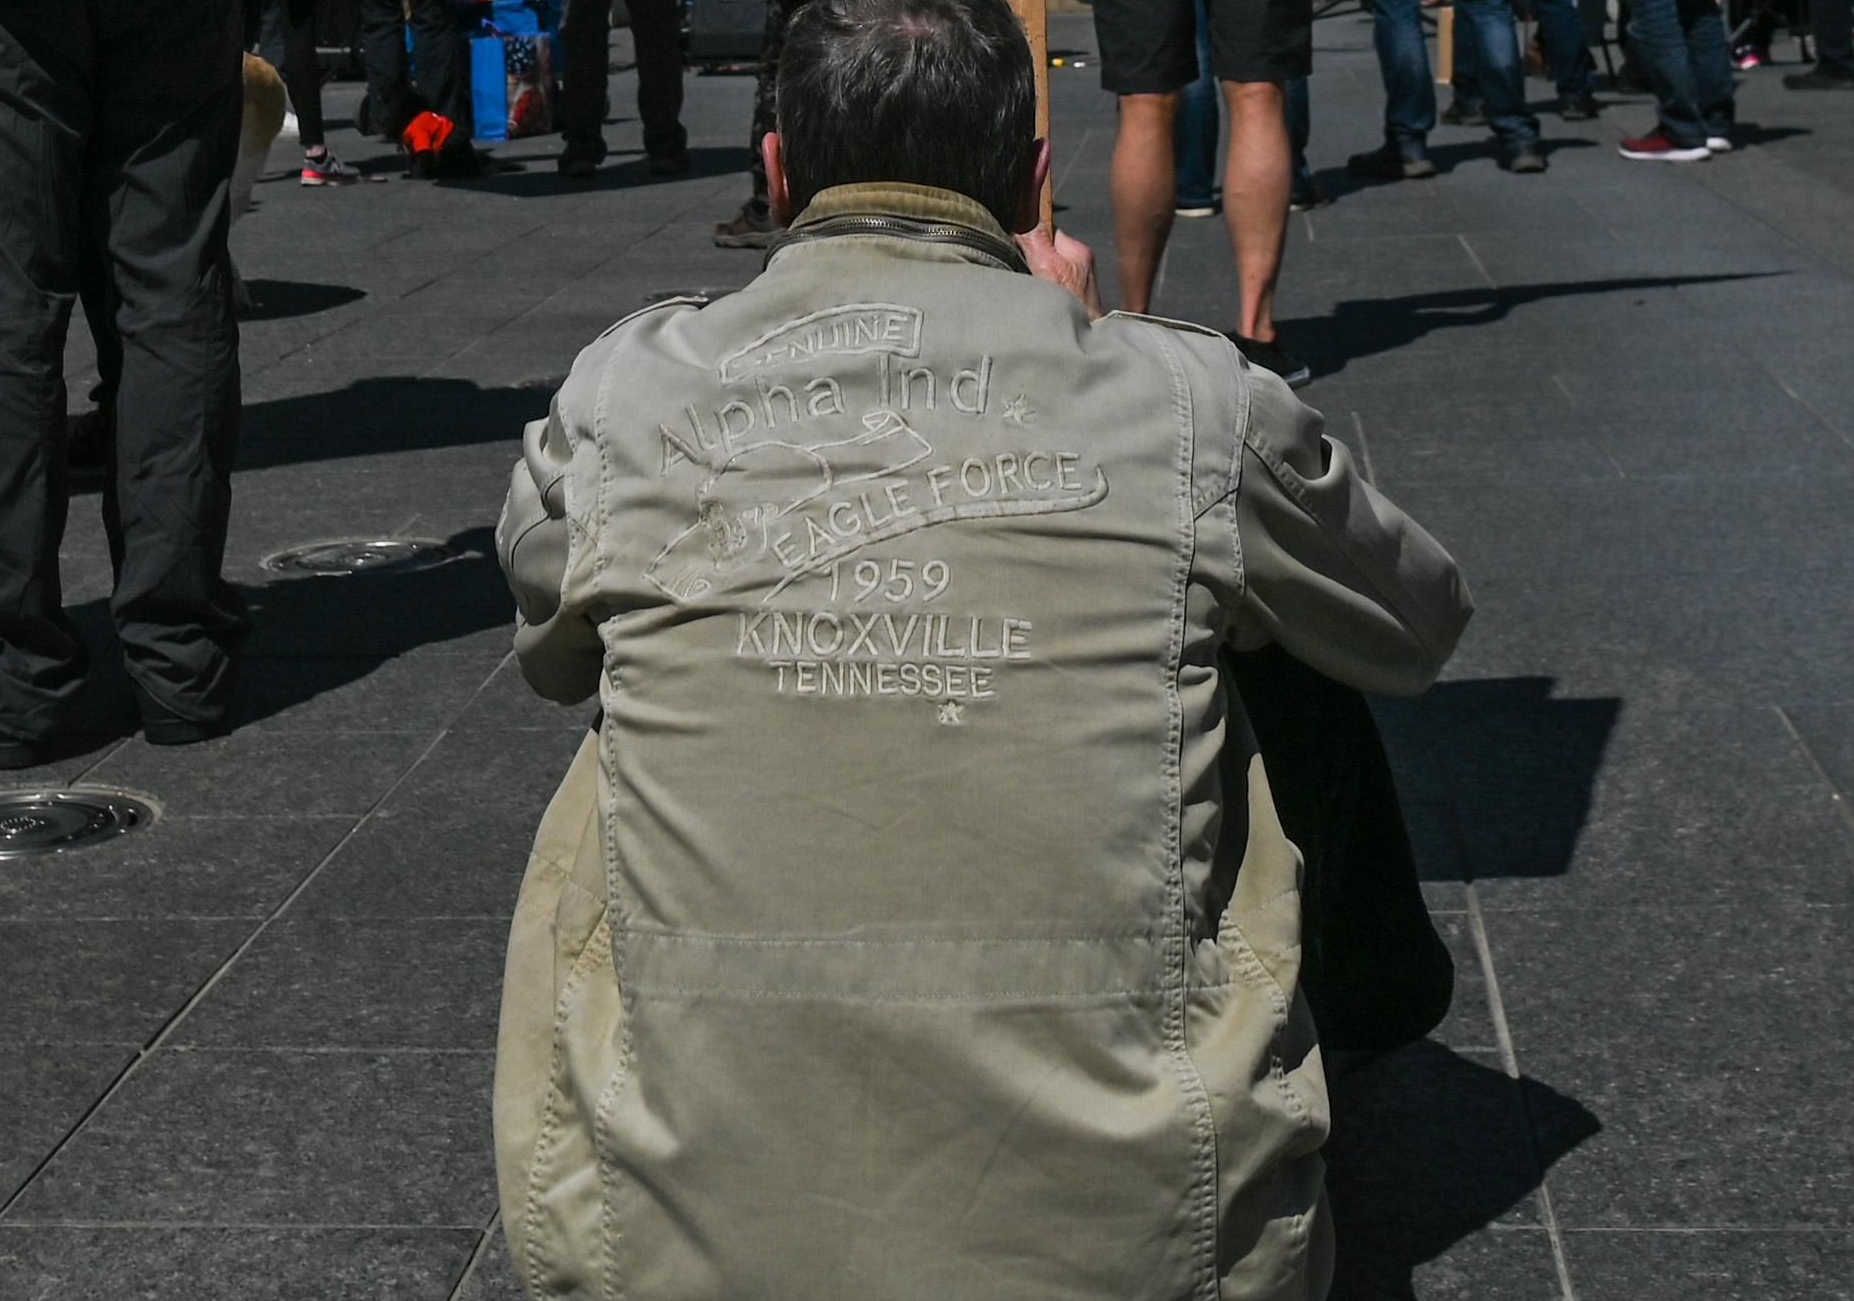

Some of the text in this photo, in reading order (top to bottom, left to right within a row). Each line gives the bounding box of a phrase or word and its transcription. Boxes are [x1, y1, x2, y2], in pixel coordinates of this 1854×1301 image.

[738, 315, 908, 368] NUINE
[657, 354, 994, 479] Alpha Ind
[771, 451, 1083, 568] EAGLE FORCE
[822, 559, 952, 603] 1959
[736, 610, 1034, 660] KNOXVILLE
[769, 661, 997, 699] TENNESSEE
